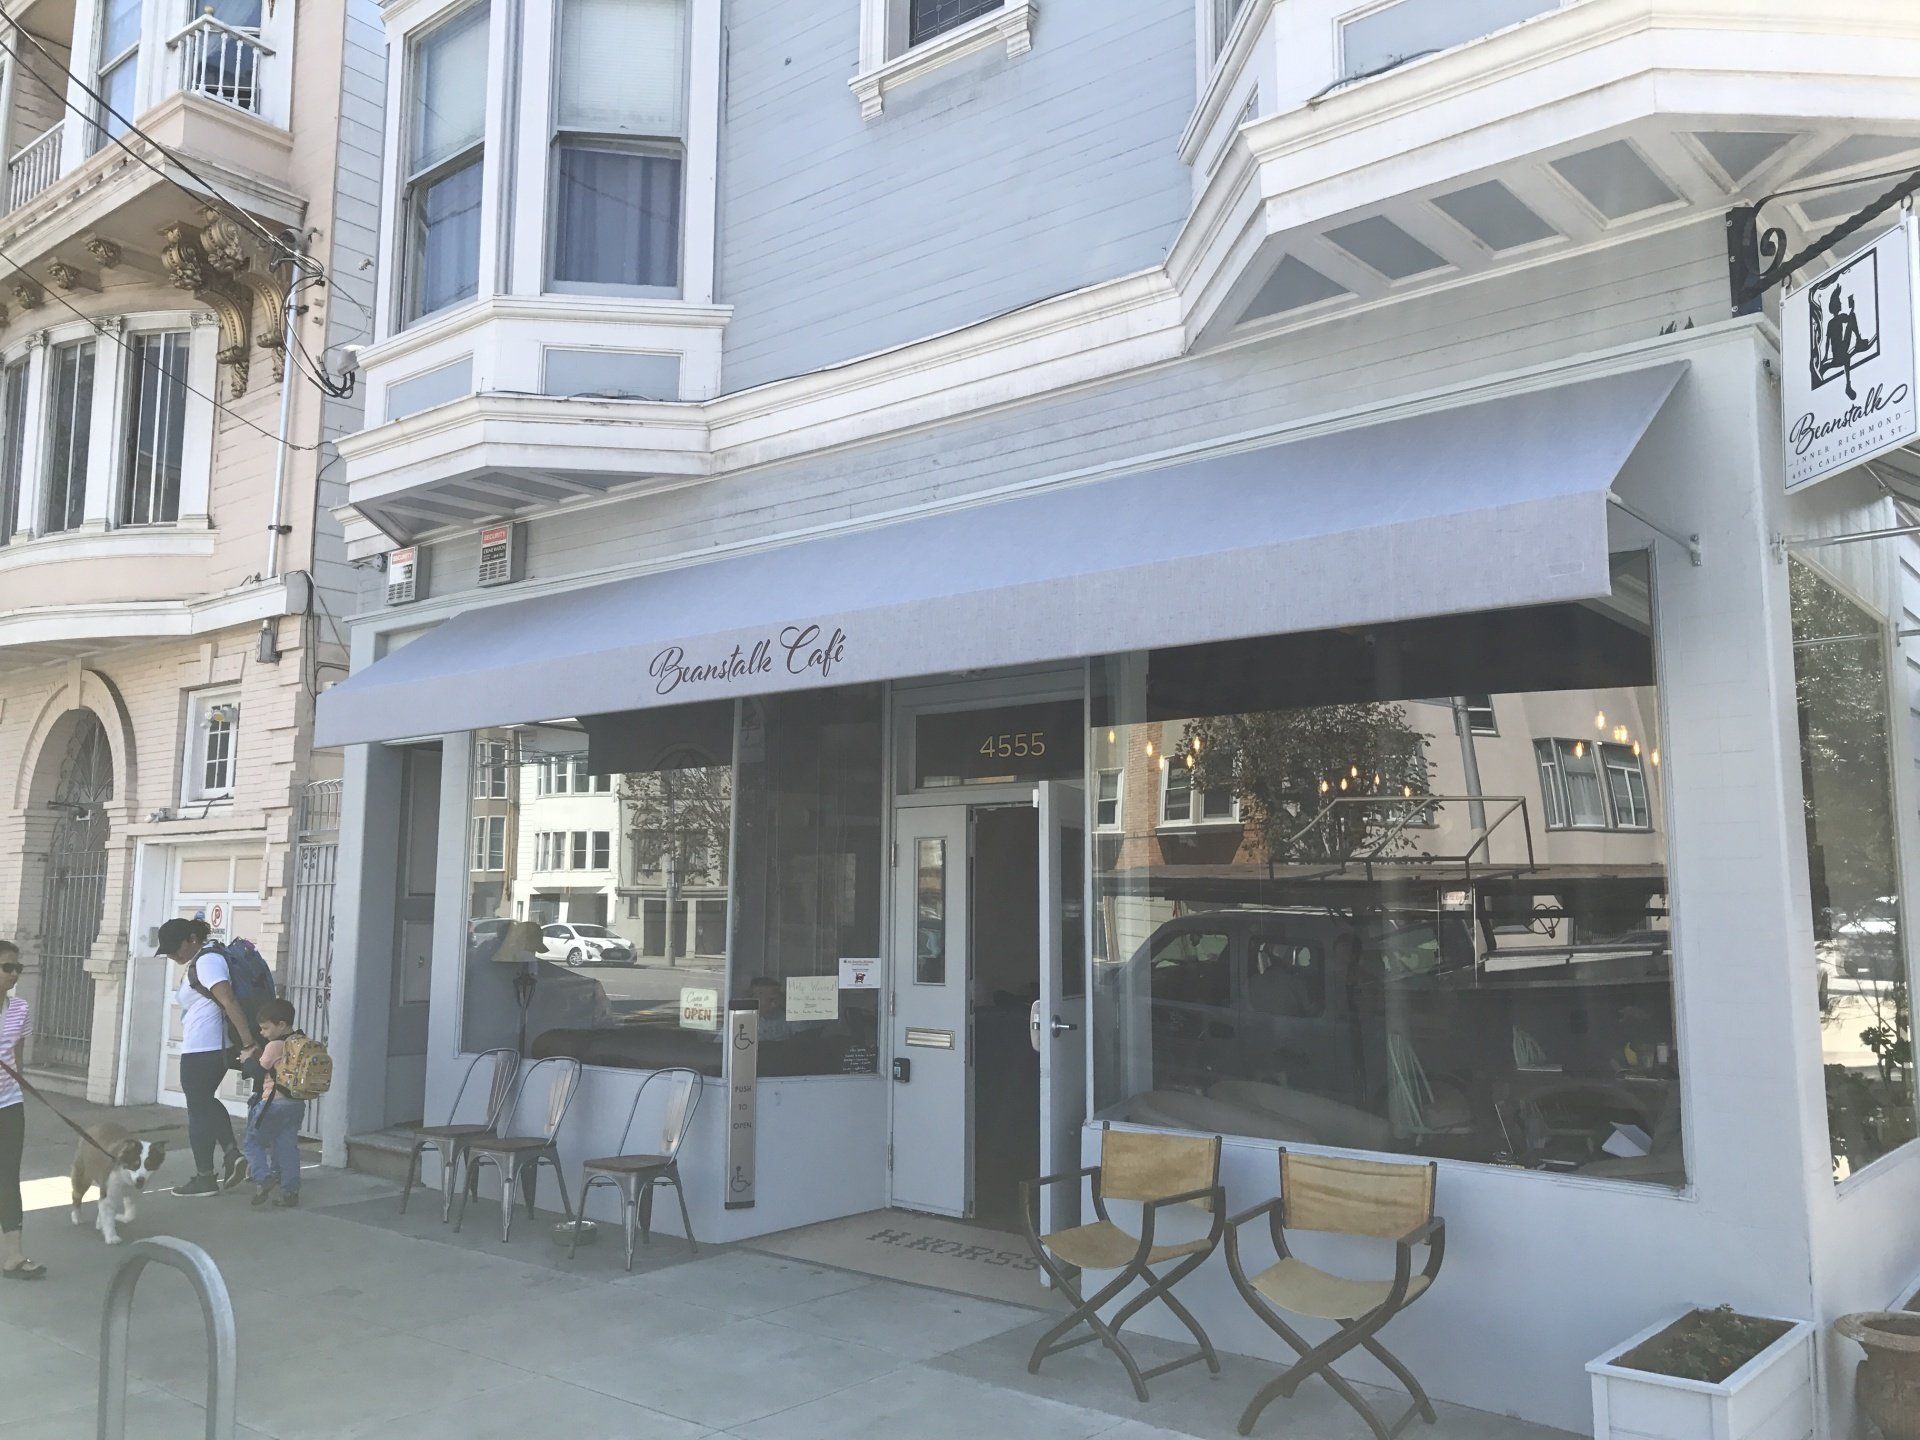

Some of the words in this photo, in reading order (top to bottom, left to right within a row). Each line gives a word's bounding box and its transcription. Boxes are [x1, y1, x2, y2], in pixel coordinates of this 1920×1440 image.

[1790, 383, 1908, 455] Beanstalk
[1796, 446, 1829, 466] INNER
[1838, 412, 1901, 447] RICHMOND
[1818, 435, 1884, 468] CALIFORNIA
[649, 639, 772, 695] Beanstalk
[779, 624, 847, 678] Café
[979, 732, 1046, 758] 4555
[684, 1007, 712, 1021] OPEN
[734, 1085, 752, 1093] PUSH
[738, 1103, 748, 1111] TO
[733, 1122, 752, 1130] OPEN
